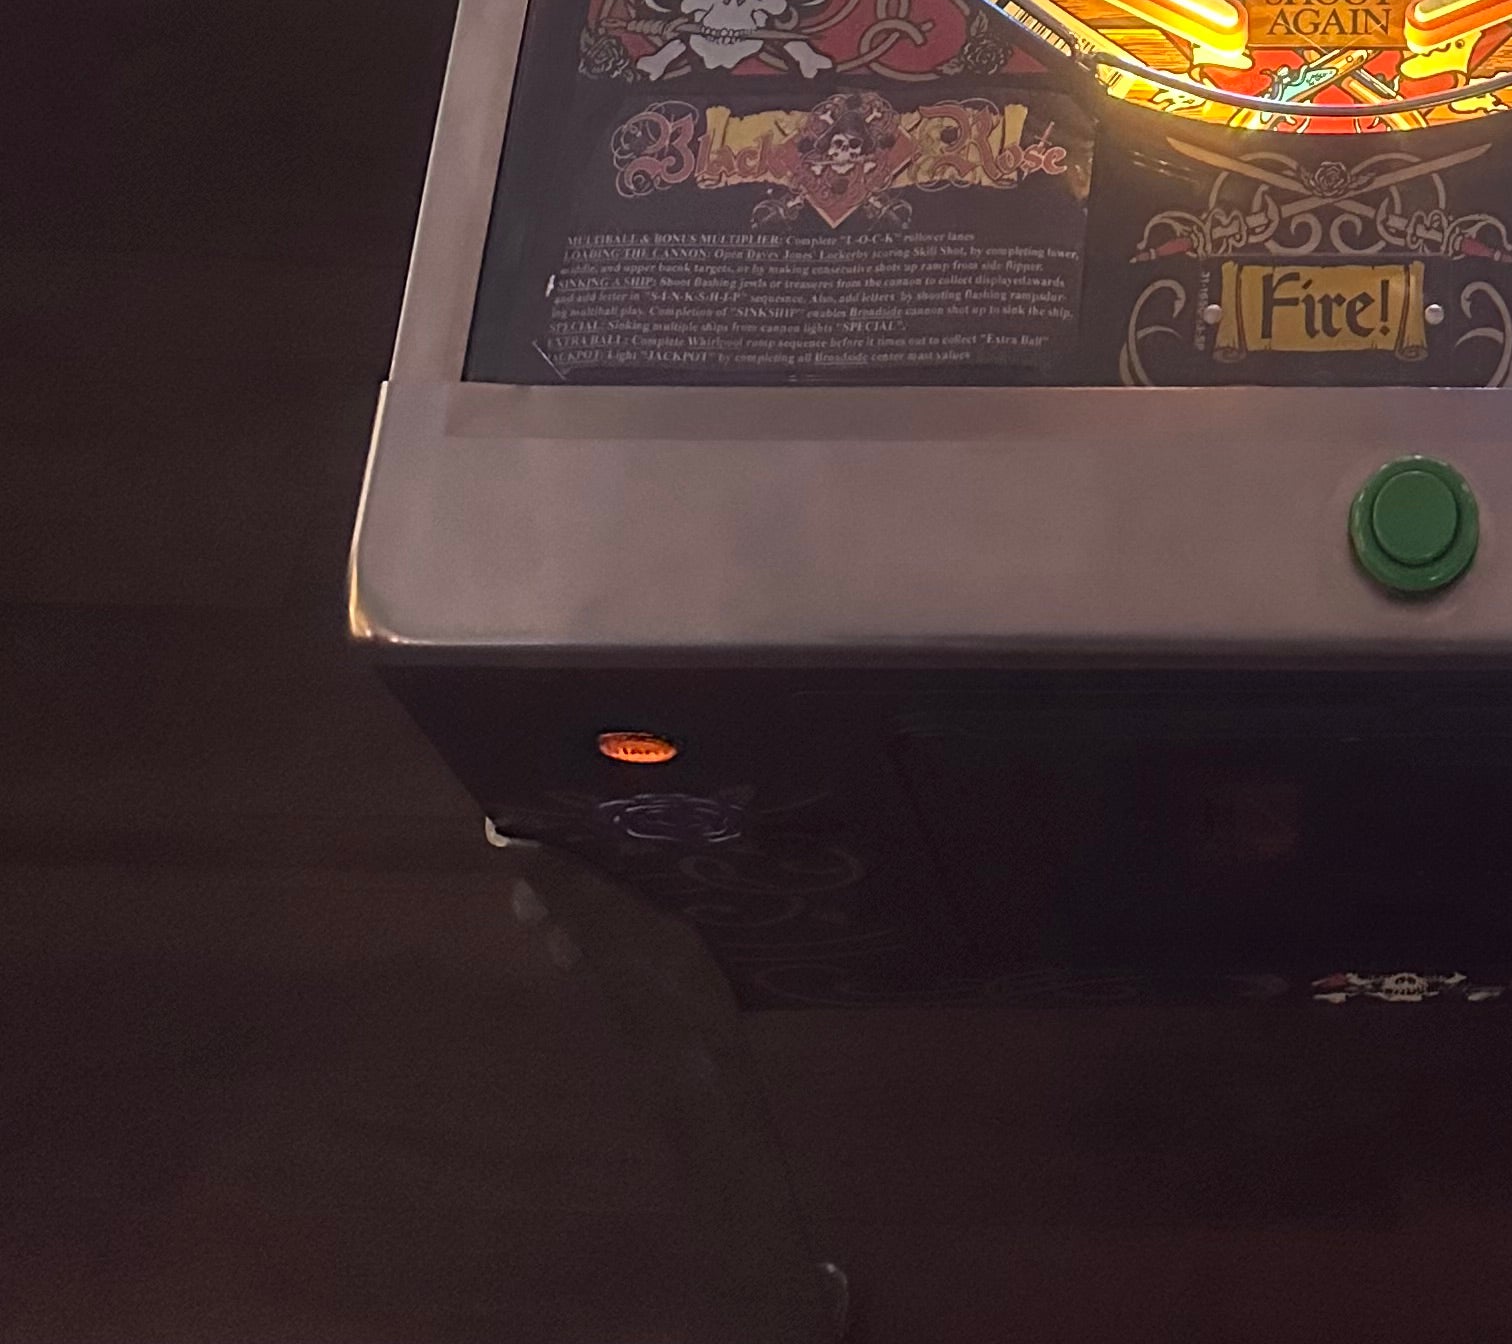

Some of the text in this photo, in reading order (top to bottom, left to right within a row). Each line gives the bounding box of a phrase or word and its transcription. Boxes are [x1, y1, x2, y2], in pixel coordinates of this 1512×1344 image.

[1266, 8, 1392, 36] AGAIN
[612, 98, 1067, 197] Black Rose
[786, 234, 837, 246] Complete
[1259, 272, 1391, 340] Fire!
